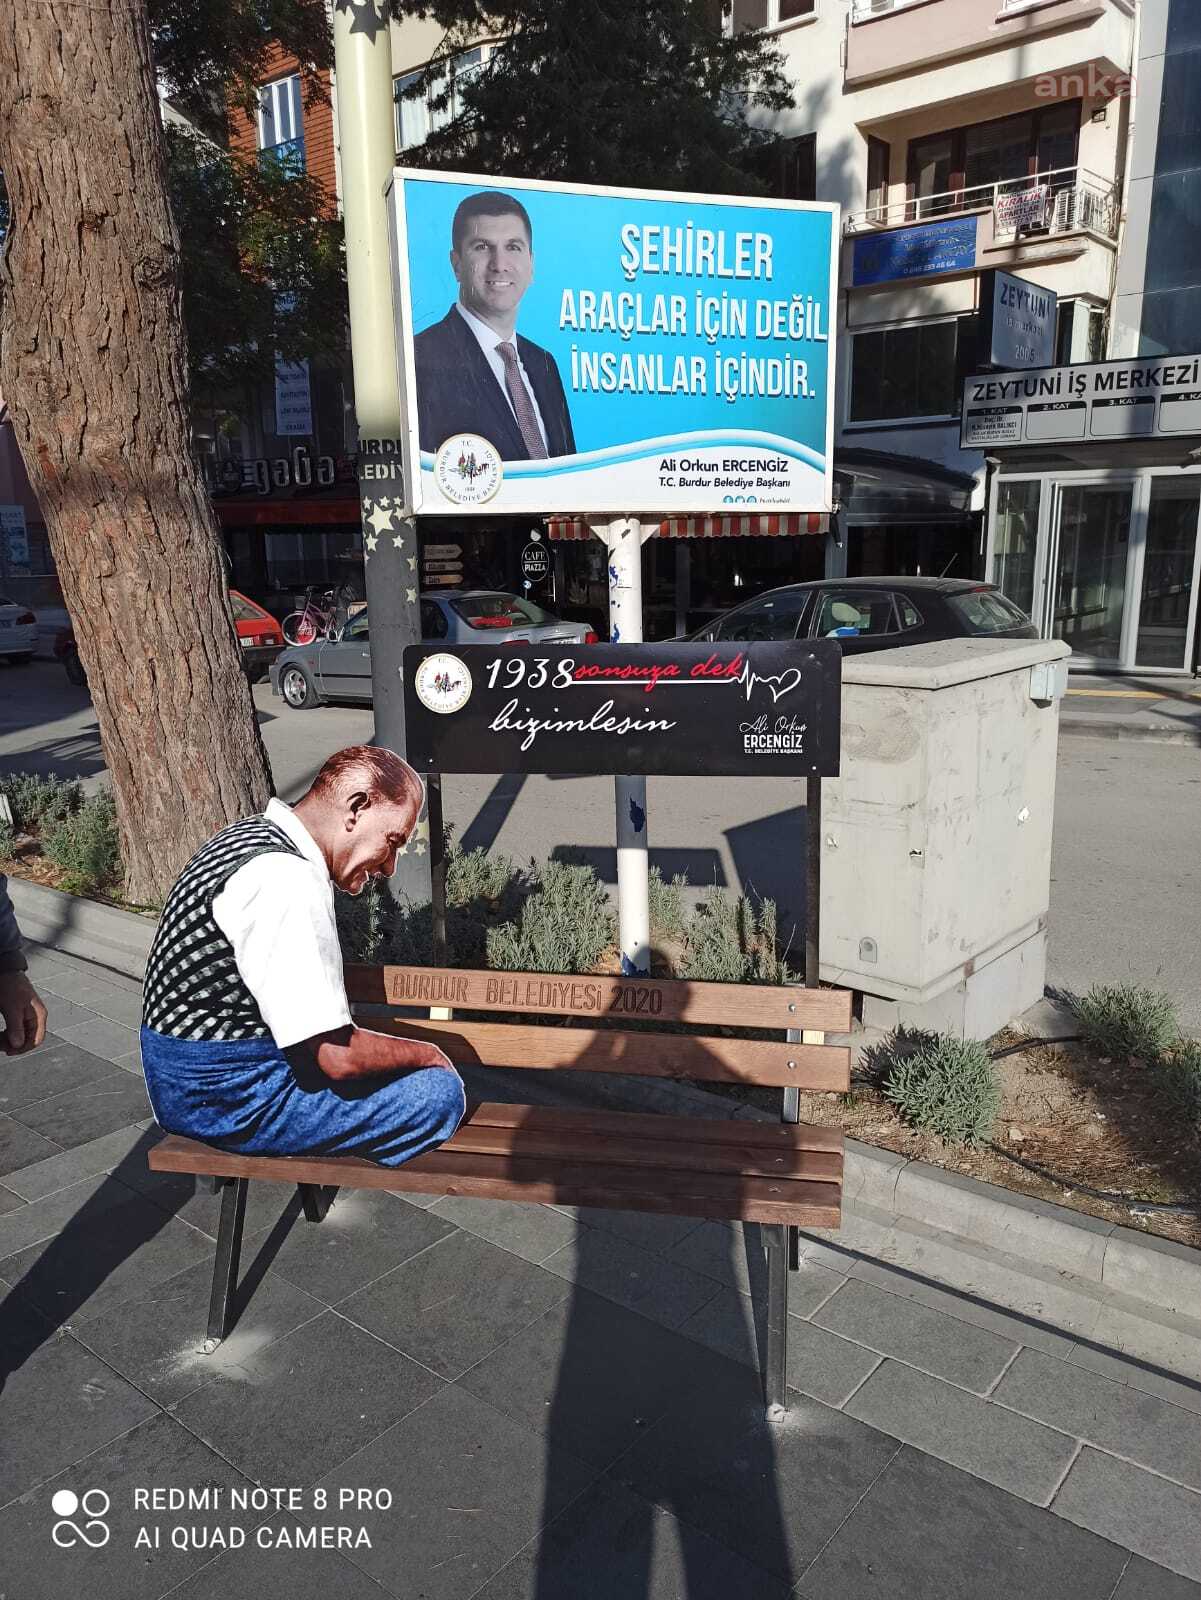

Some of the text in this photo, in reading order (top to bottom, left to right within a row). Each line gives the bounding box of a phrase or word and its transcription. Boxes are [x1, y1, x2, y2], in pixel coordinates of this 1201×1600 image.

[620, 220, 773, 281] ŞEHİRLER
[559, 288, 827, 345] ARAÇLAR İÇİN DEĞİL
[571, 343, 816, 404] İNSANLAR İÇİNDİR.
[972, 359, 1199, 401] ZEYTUNİ İŞ MERKEZİ
[1052, 402, 1070, 410] KAT
[658, 476, 791, 489] T.C. Burdur Belediye Başkanı
[659, 456, 789, 473] Ali Orkun ERCENGİZ
[524, 563, 546, 572] PIAZZA
[486, 658, 574, 689] 1938
[574, 663, 681, 692] sonsuza
[690, 653, 744, 678] dek
[488, 698, 677, 751] bizimlesin
[739, 714, 807, 734] Ali Orkun
[744, 731, 803, 748] ERCENGİZ
[392, 973, 470, 1003] BURDUR
[611, 985, 663, 1015] 2020
